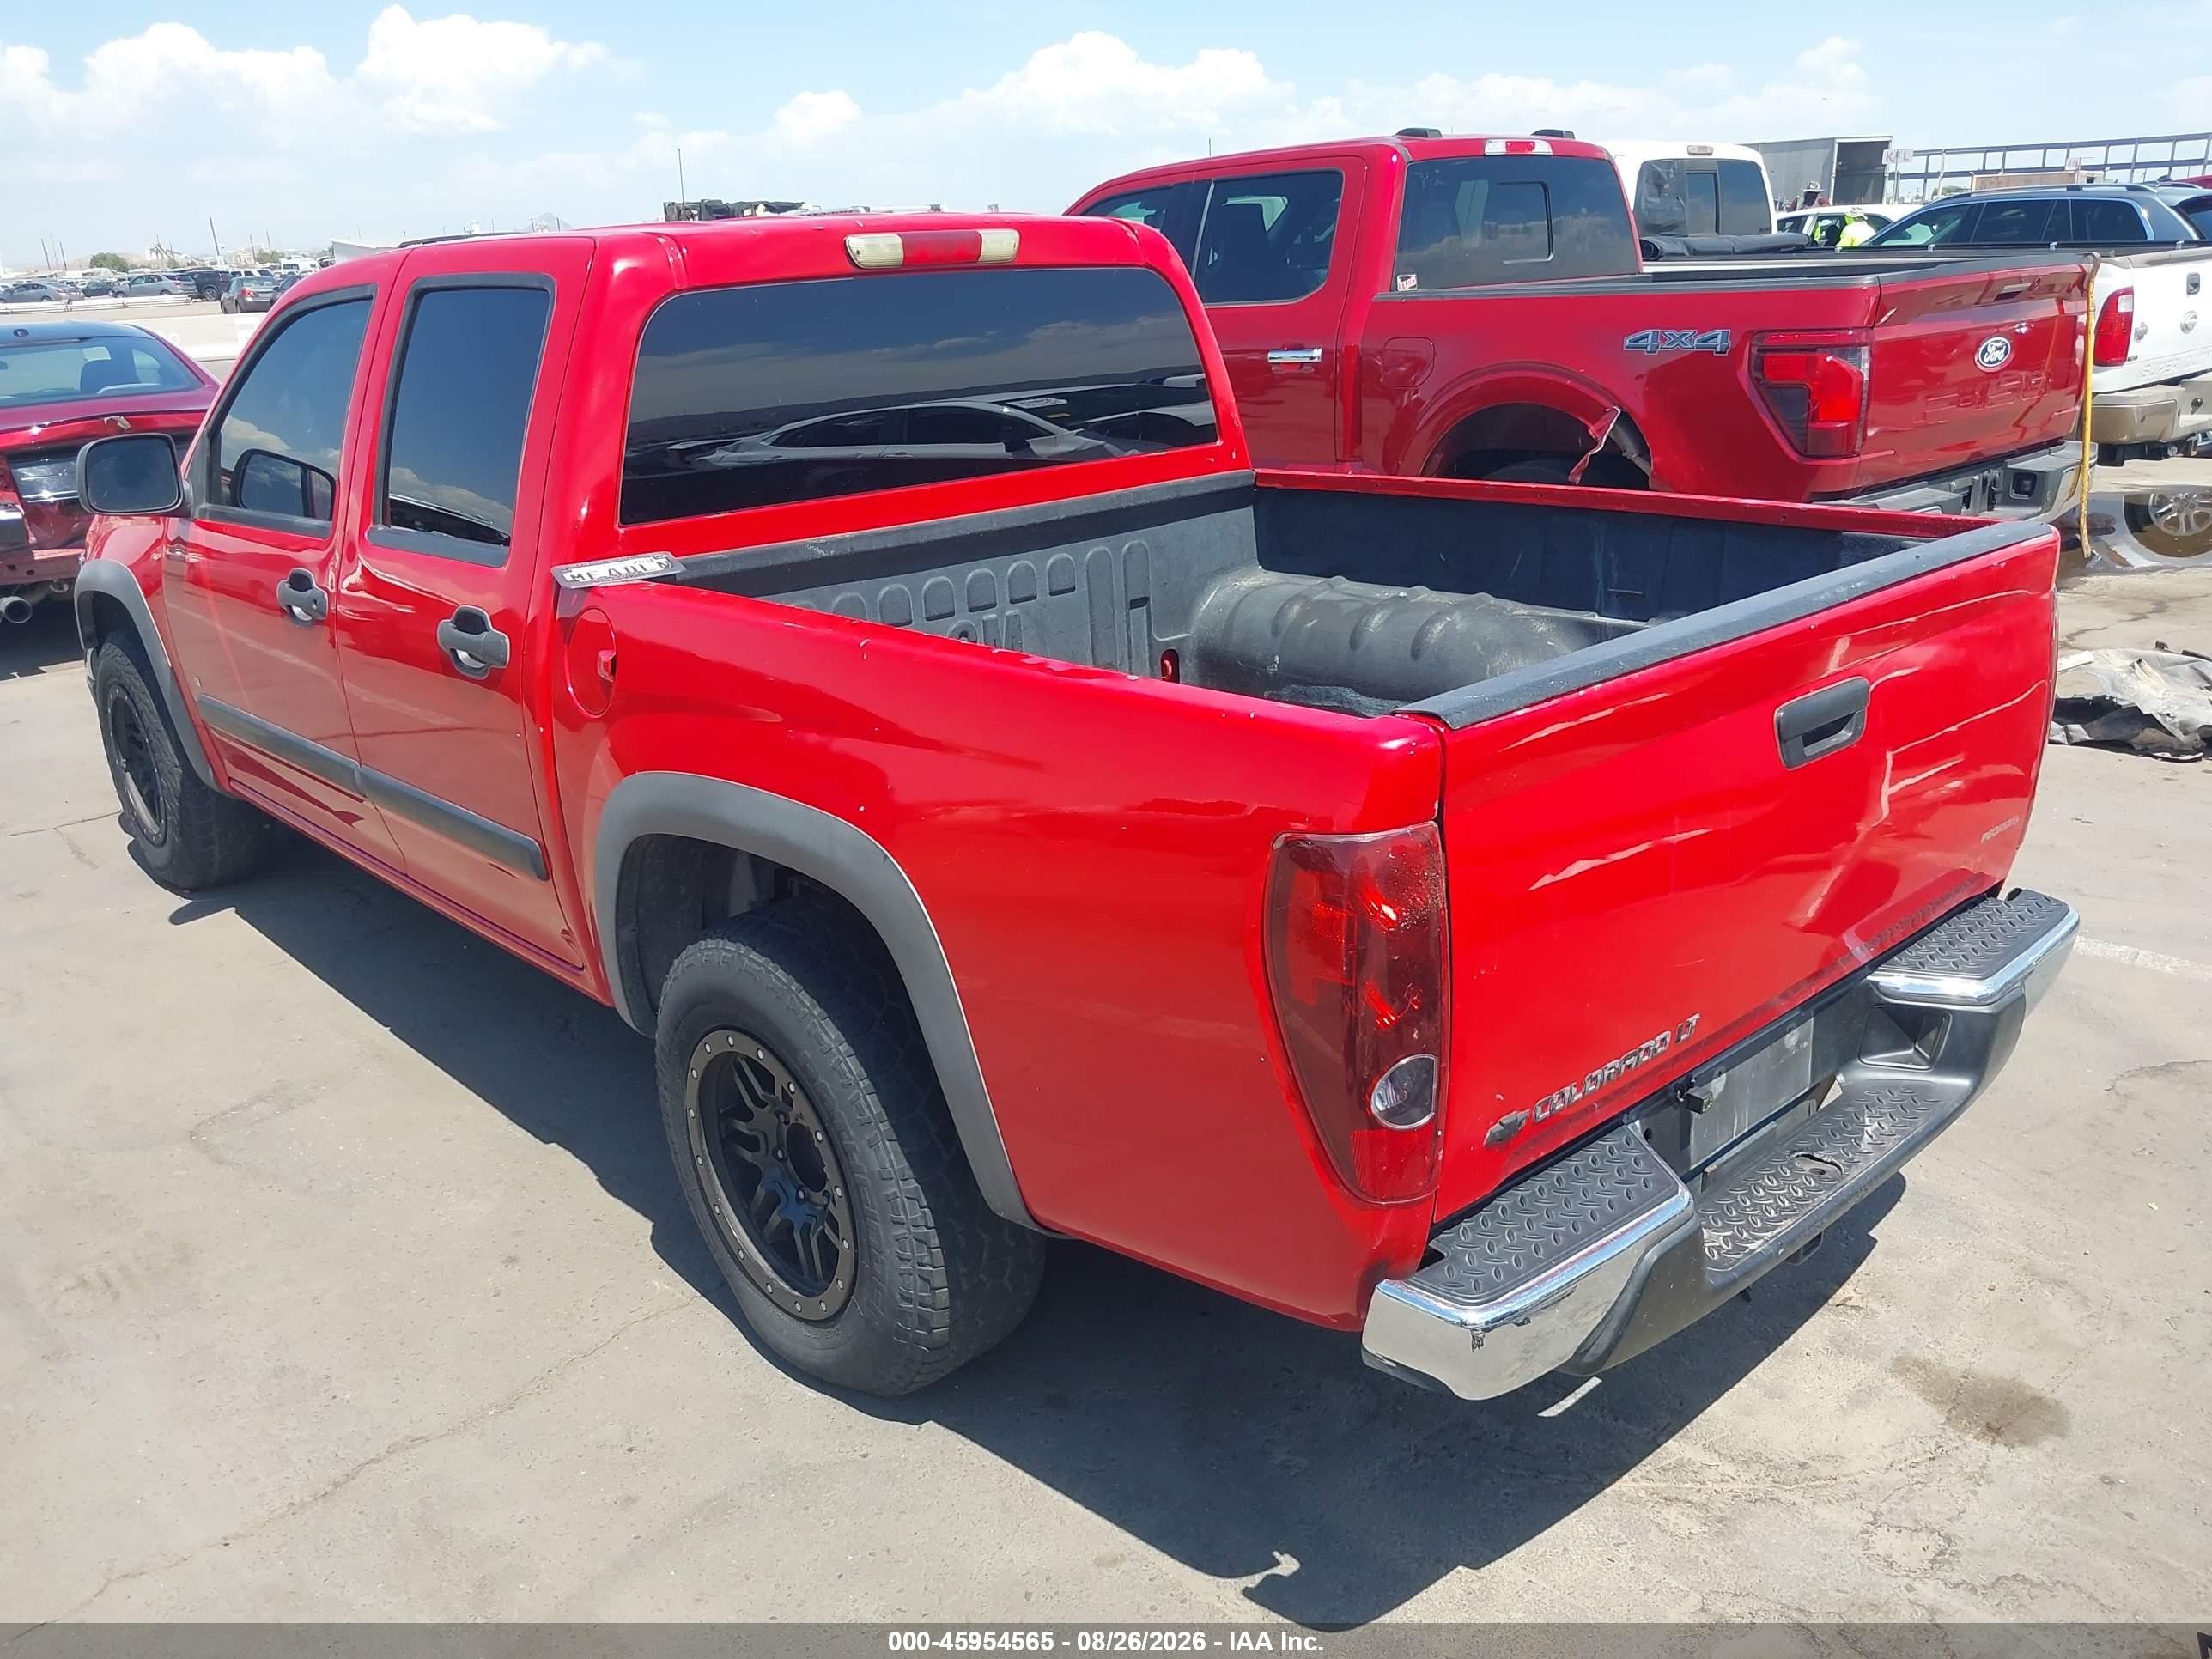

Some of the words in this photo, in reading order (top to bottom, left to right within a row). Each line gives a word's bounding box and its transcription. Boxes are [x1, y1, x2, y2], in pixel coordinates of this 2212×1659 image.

[1984, 341, 2007, 363] Ford
[1534, 1030, 1671, 1122] COLORADO
[1675, 1013, 1701, 1043] LT
